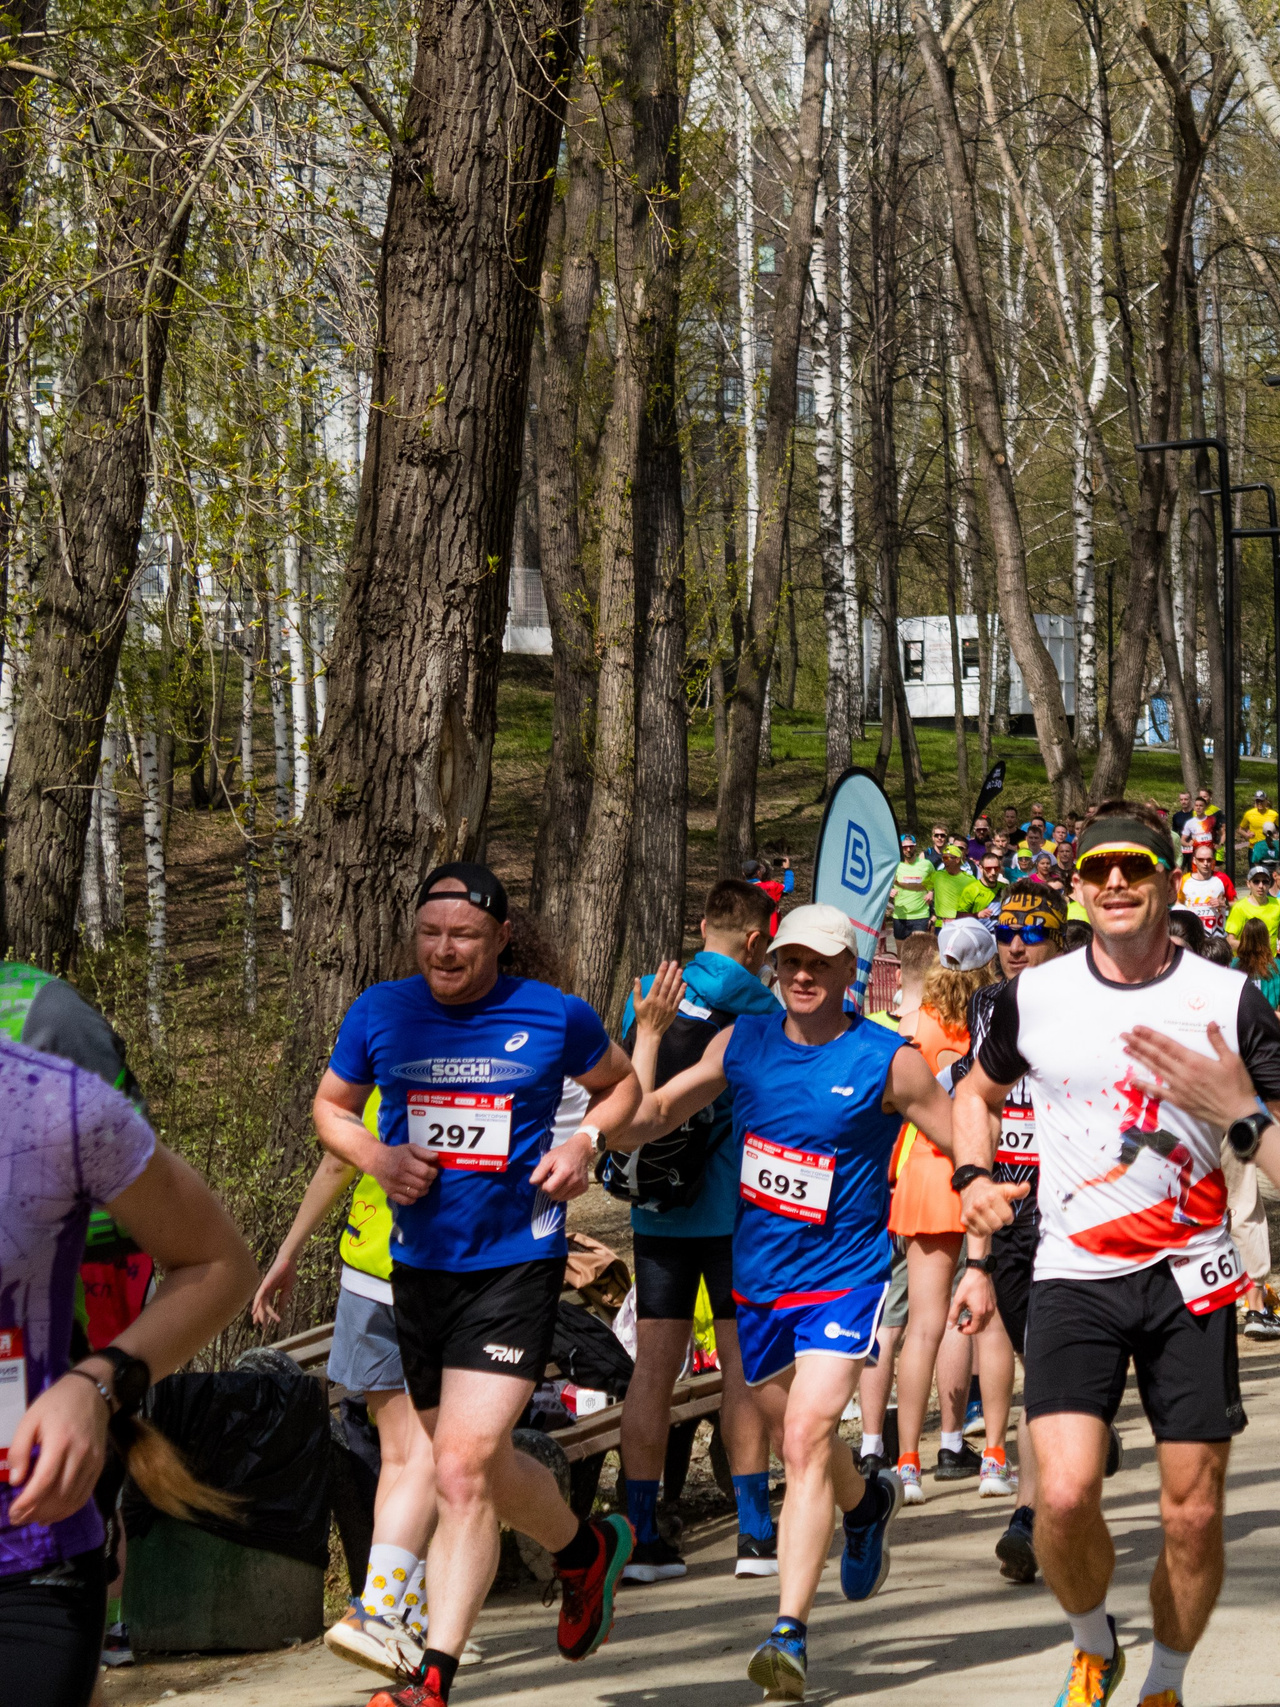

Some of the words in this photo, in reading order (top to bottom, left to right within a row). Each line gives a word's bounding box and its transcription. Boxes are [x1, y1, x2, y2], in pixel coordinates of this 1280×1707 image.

[431, 1063, 490, 1076] SOCHI
[432, 1076, 490, 1084] MARATHON
[427, 1123, 486, 1149] 297
[758, 1168, 809, 1201] 693
